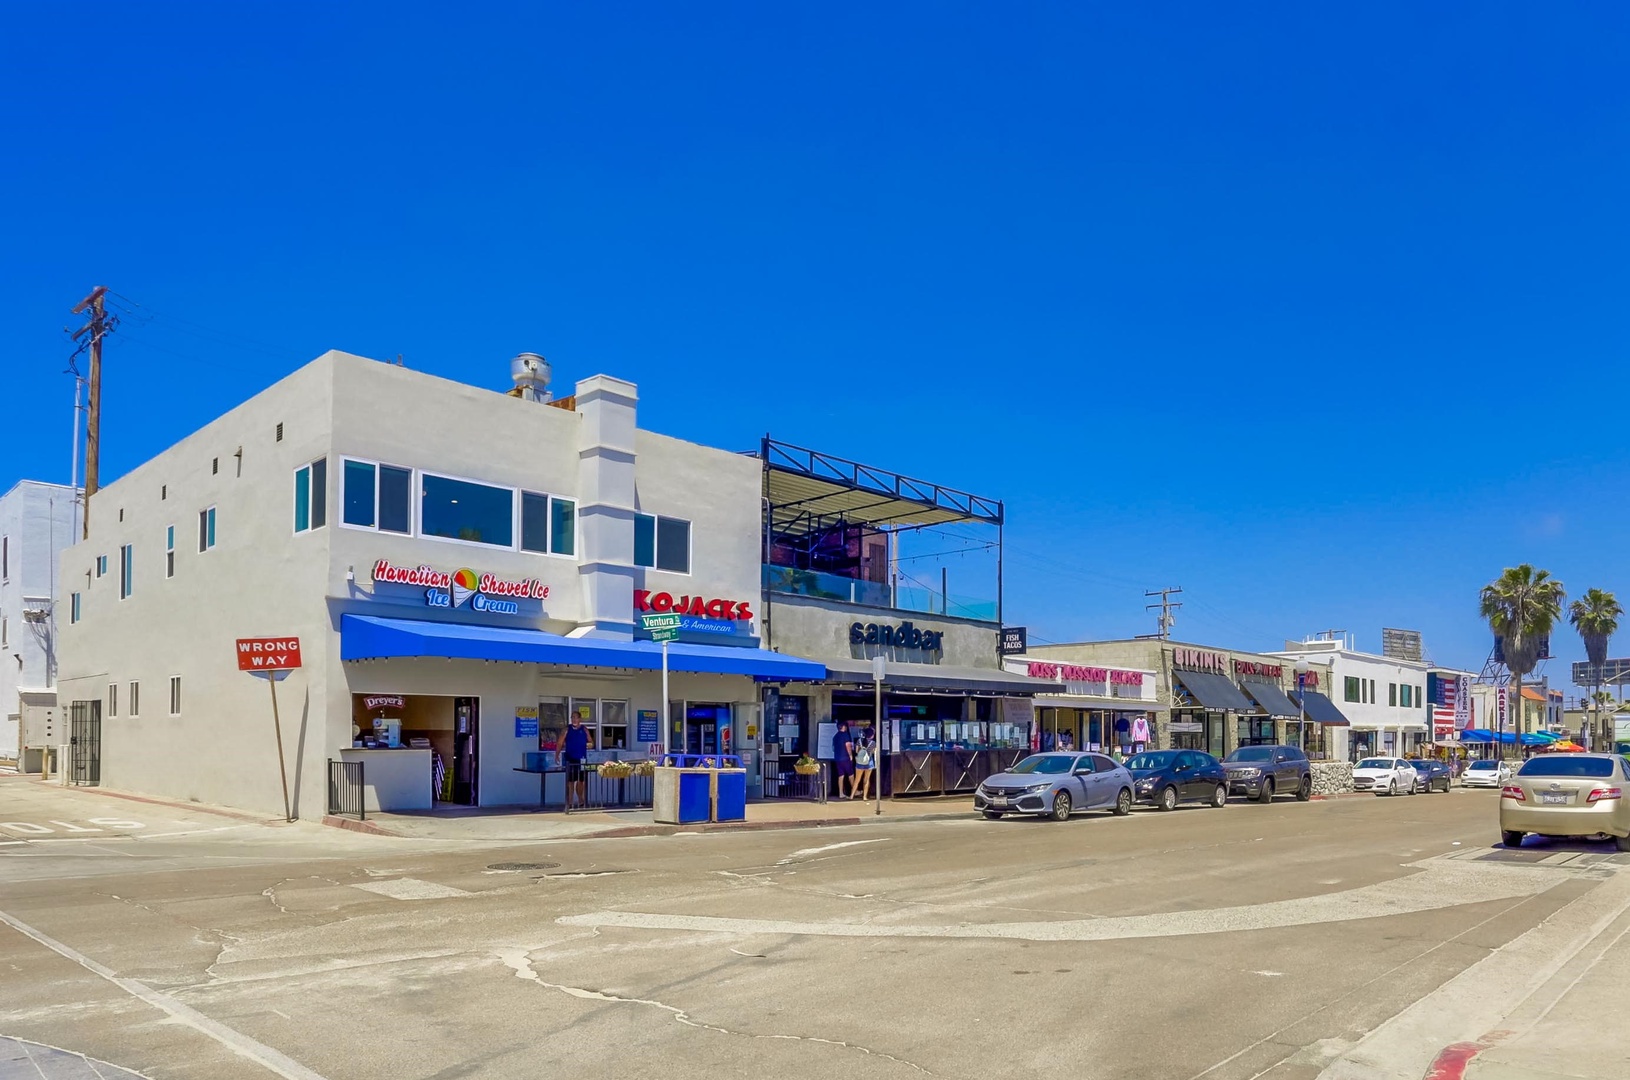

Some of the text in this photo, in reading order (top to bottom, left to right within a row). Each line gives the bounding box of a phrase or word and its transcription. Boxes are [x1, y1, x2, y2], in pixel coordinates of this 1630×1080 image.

[374, 560, 550, 599] Hawaiian Shaved Ice
[426, 589, 518, 614] Ice Cream
[633, 589, 754, 620] KOJACKS
[643, 616, 674, 627] Ventura
[682, 620, 732, 633] & American
[849, 620, 944, 651] sandbar
[1006, 634, 1020, 642] FISH
[239, 641, 298, 652] WRONG
[1003, 641, 1022, 650] TACOS
[251, 655, 288, 666] WAY
[1174, 648, 1227, 671] BIKINIS
[1028, 661, 1058, 679] MISS
[1061, 664, 1107, 683] MISSION
